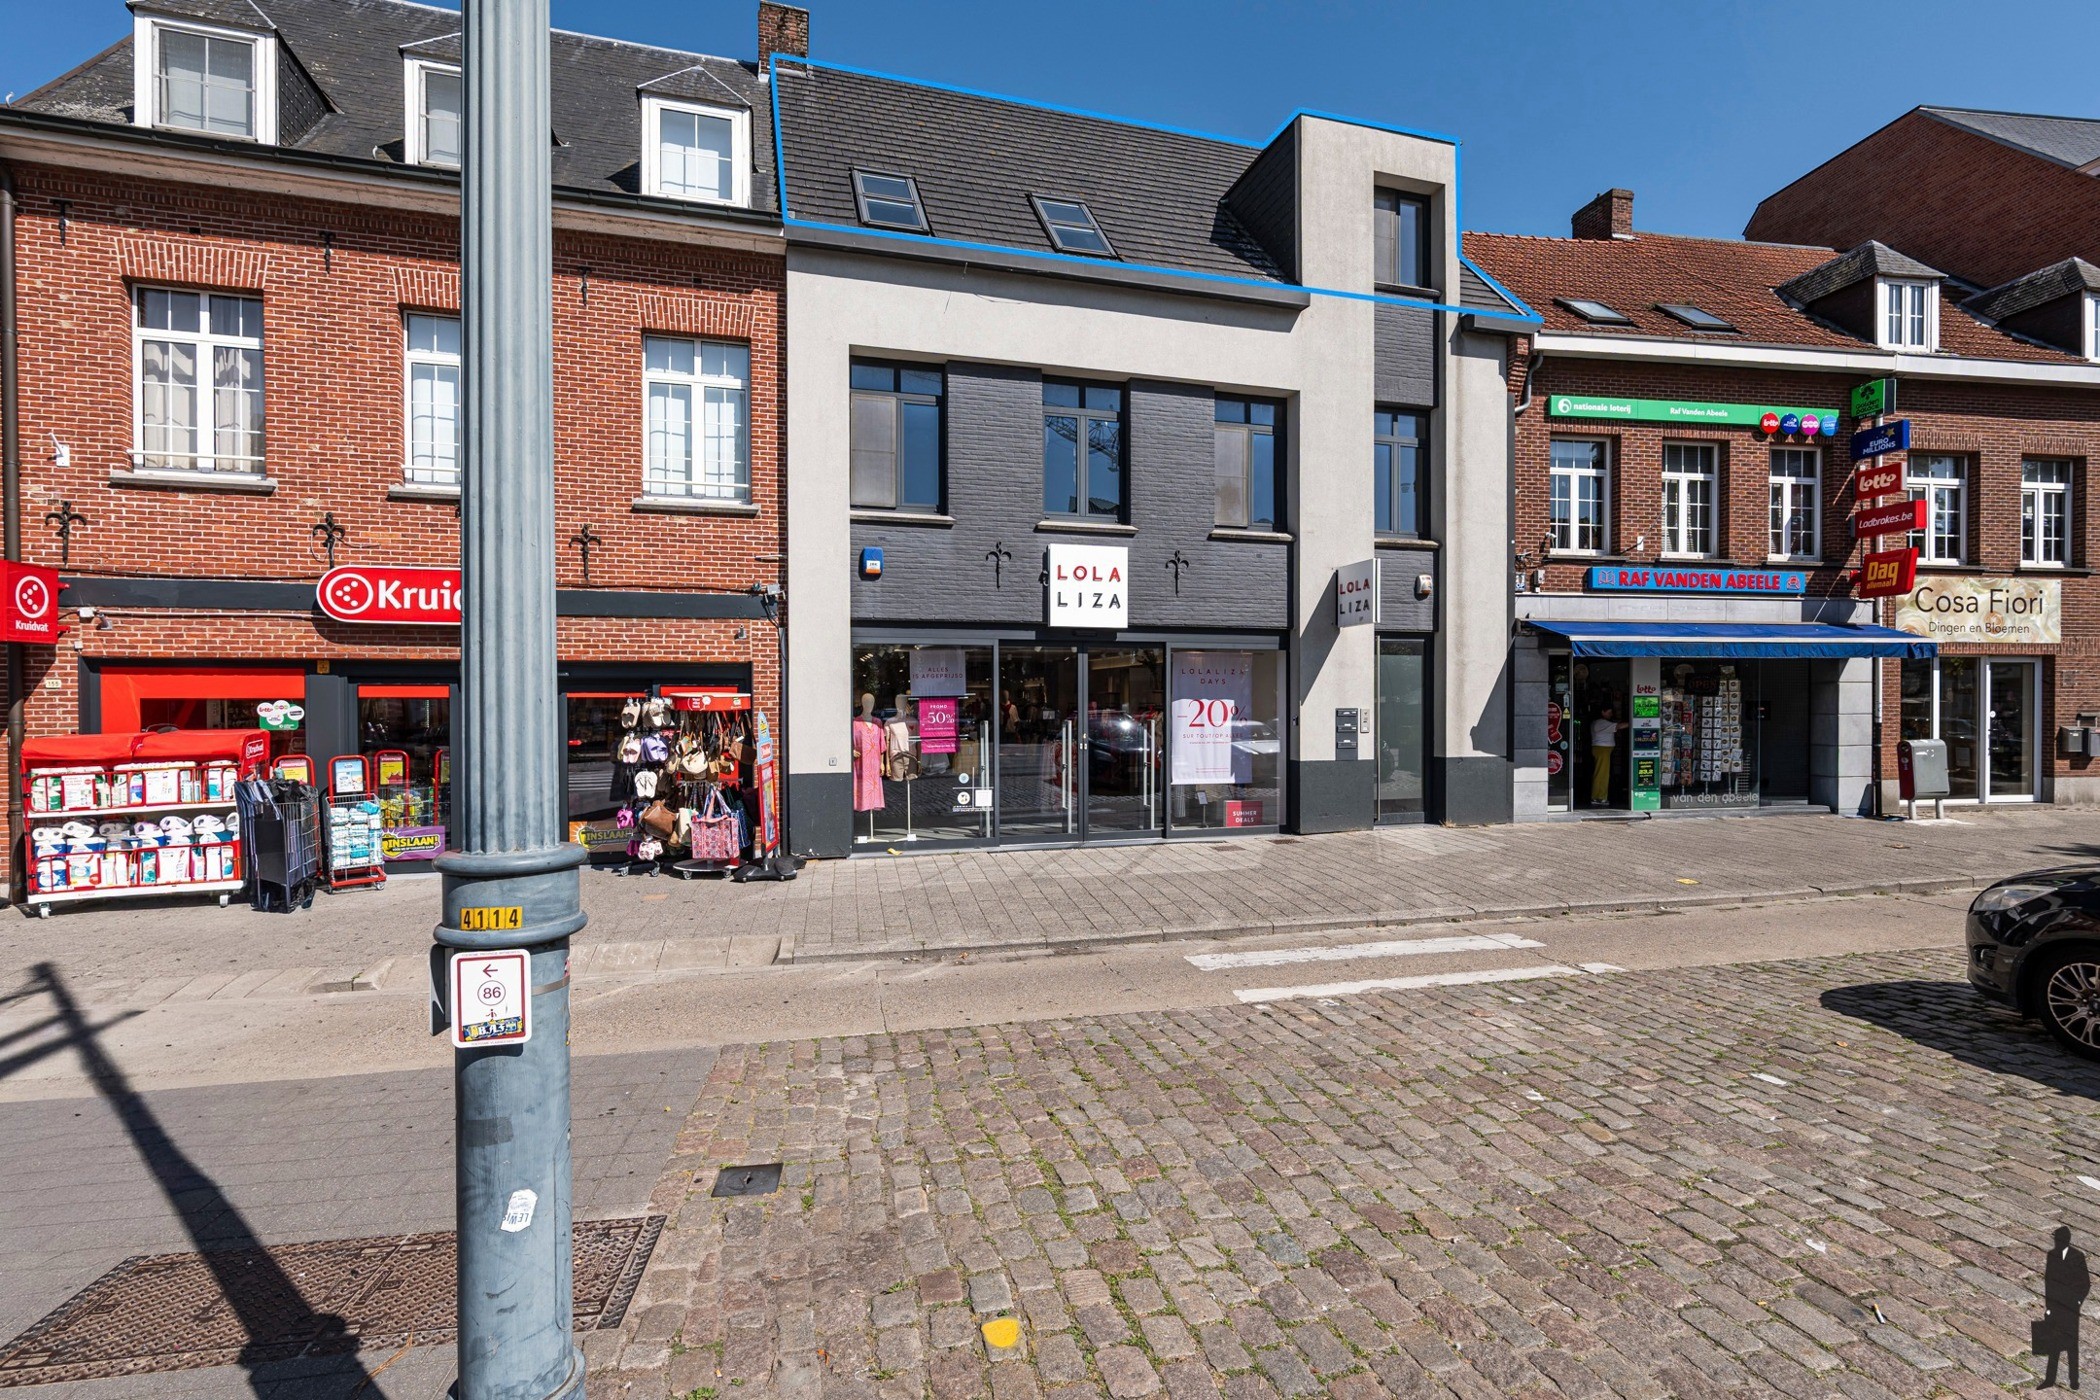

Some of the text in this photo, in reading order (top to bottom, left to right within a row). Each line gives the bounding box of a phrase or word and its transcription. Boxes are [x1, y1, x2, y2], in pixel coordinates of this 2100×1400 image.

[1573, 403, 1631, 414] nationale loterij
[1670, 407, 1728, 417] Raf Vanden Abeele
[1862, 441, 1896, 455] MILLIONS
[1869, 437, 1889, 447] EURO
[1858, 512, 1913, 529] Ladbrokes.be
[1057, 565, 1121, 582] LOLA
[1618, 571, 1780, 590] RAF VANDEN ABEELE
[1866, 561, 1900, 586] Dag
[1339, 578, 1371, 595] LOLA
[1057, 591, 1121, 609] LIZA
[1339, 599, 1371, 615] LIZA
[1915, 586, 2044, 614] Cosa Fiori
[15, 620, 49, 632] Kruidvat
[1928, 622, 2030, 635] Dingen en Bloemen
[1177, 699, 1248, 728] -20%
[1672, 794, 1693, 803] van
[1697, 792, 1718, 803] den
[387, 834, 440, 848] INSLAAN!
[463, 908, 518, 929] 4114
[483, 986, 502, 999] 86
